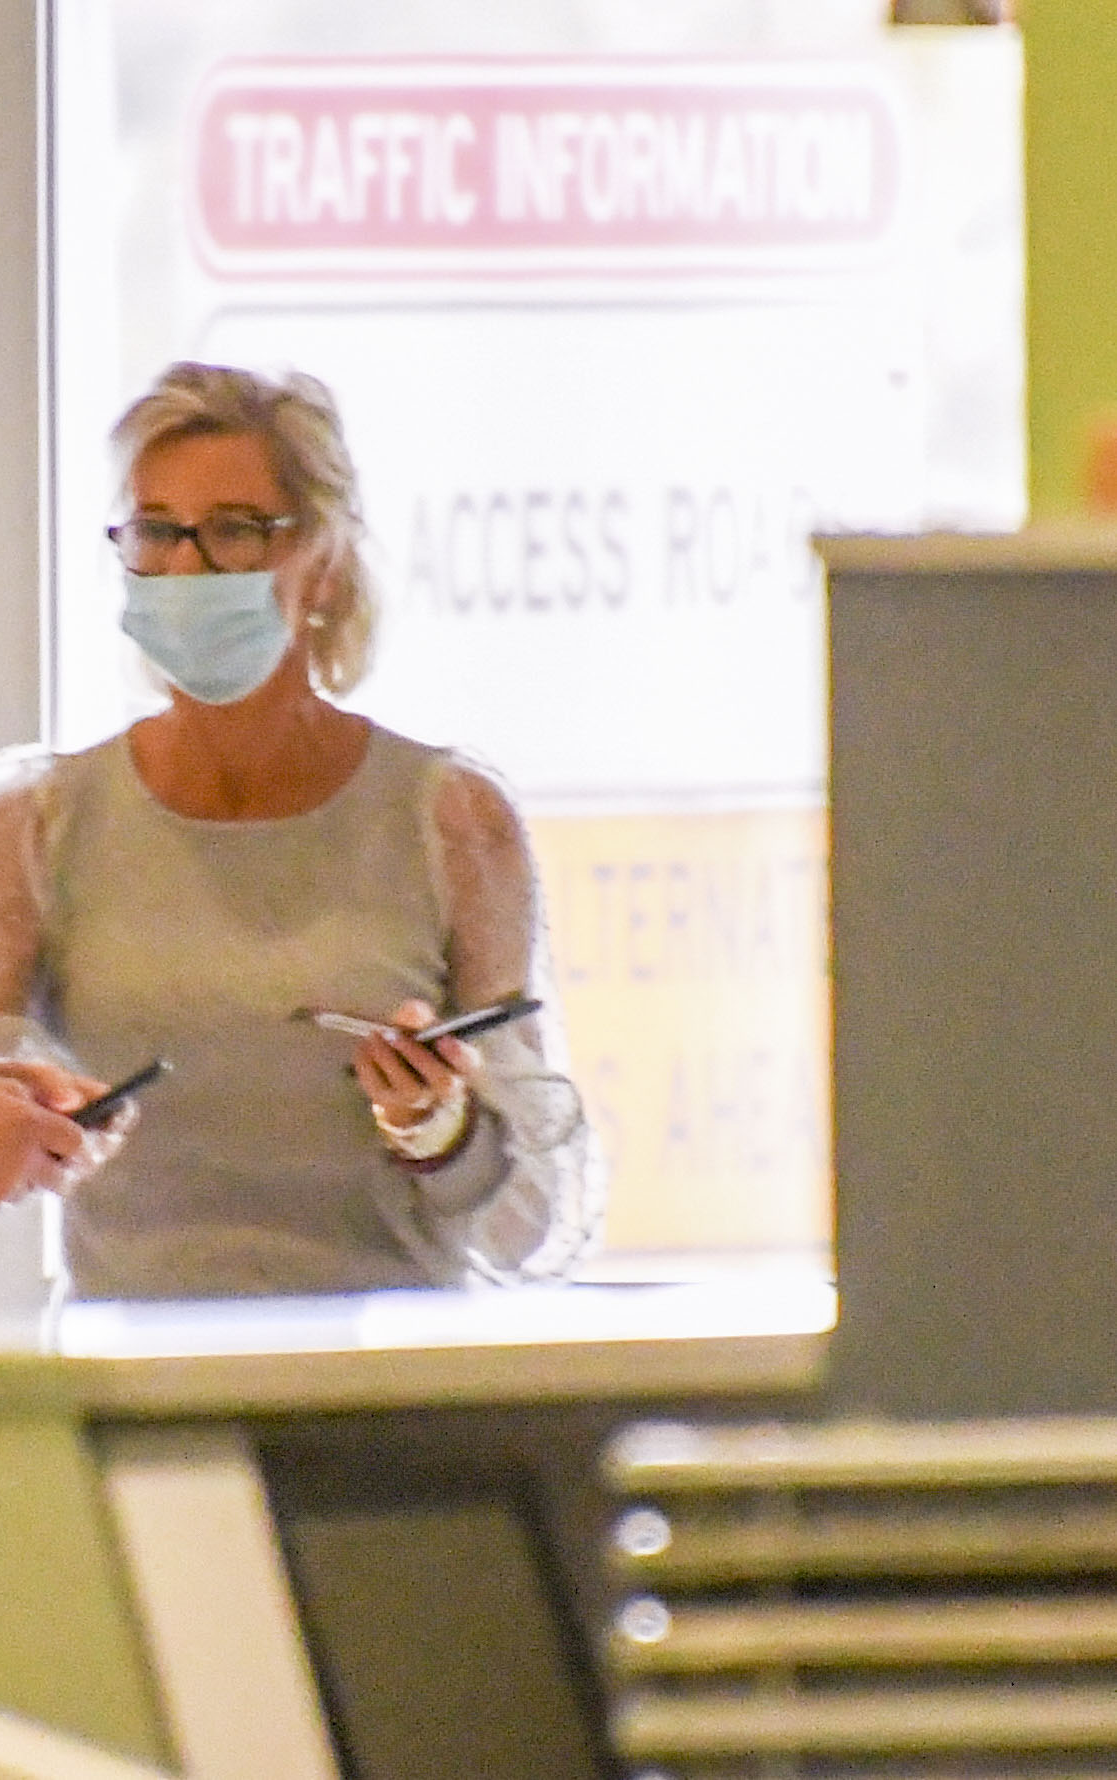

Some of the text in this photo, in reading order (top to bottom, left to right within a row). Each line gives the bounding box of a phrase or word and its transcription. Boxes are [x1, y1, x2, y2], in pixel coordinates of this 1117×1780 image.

[225, 106, 873, 226] TRAFFIC INFORMATION
[405, 489, 632, 616] ACCESS
